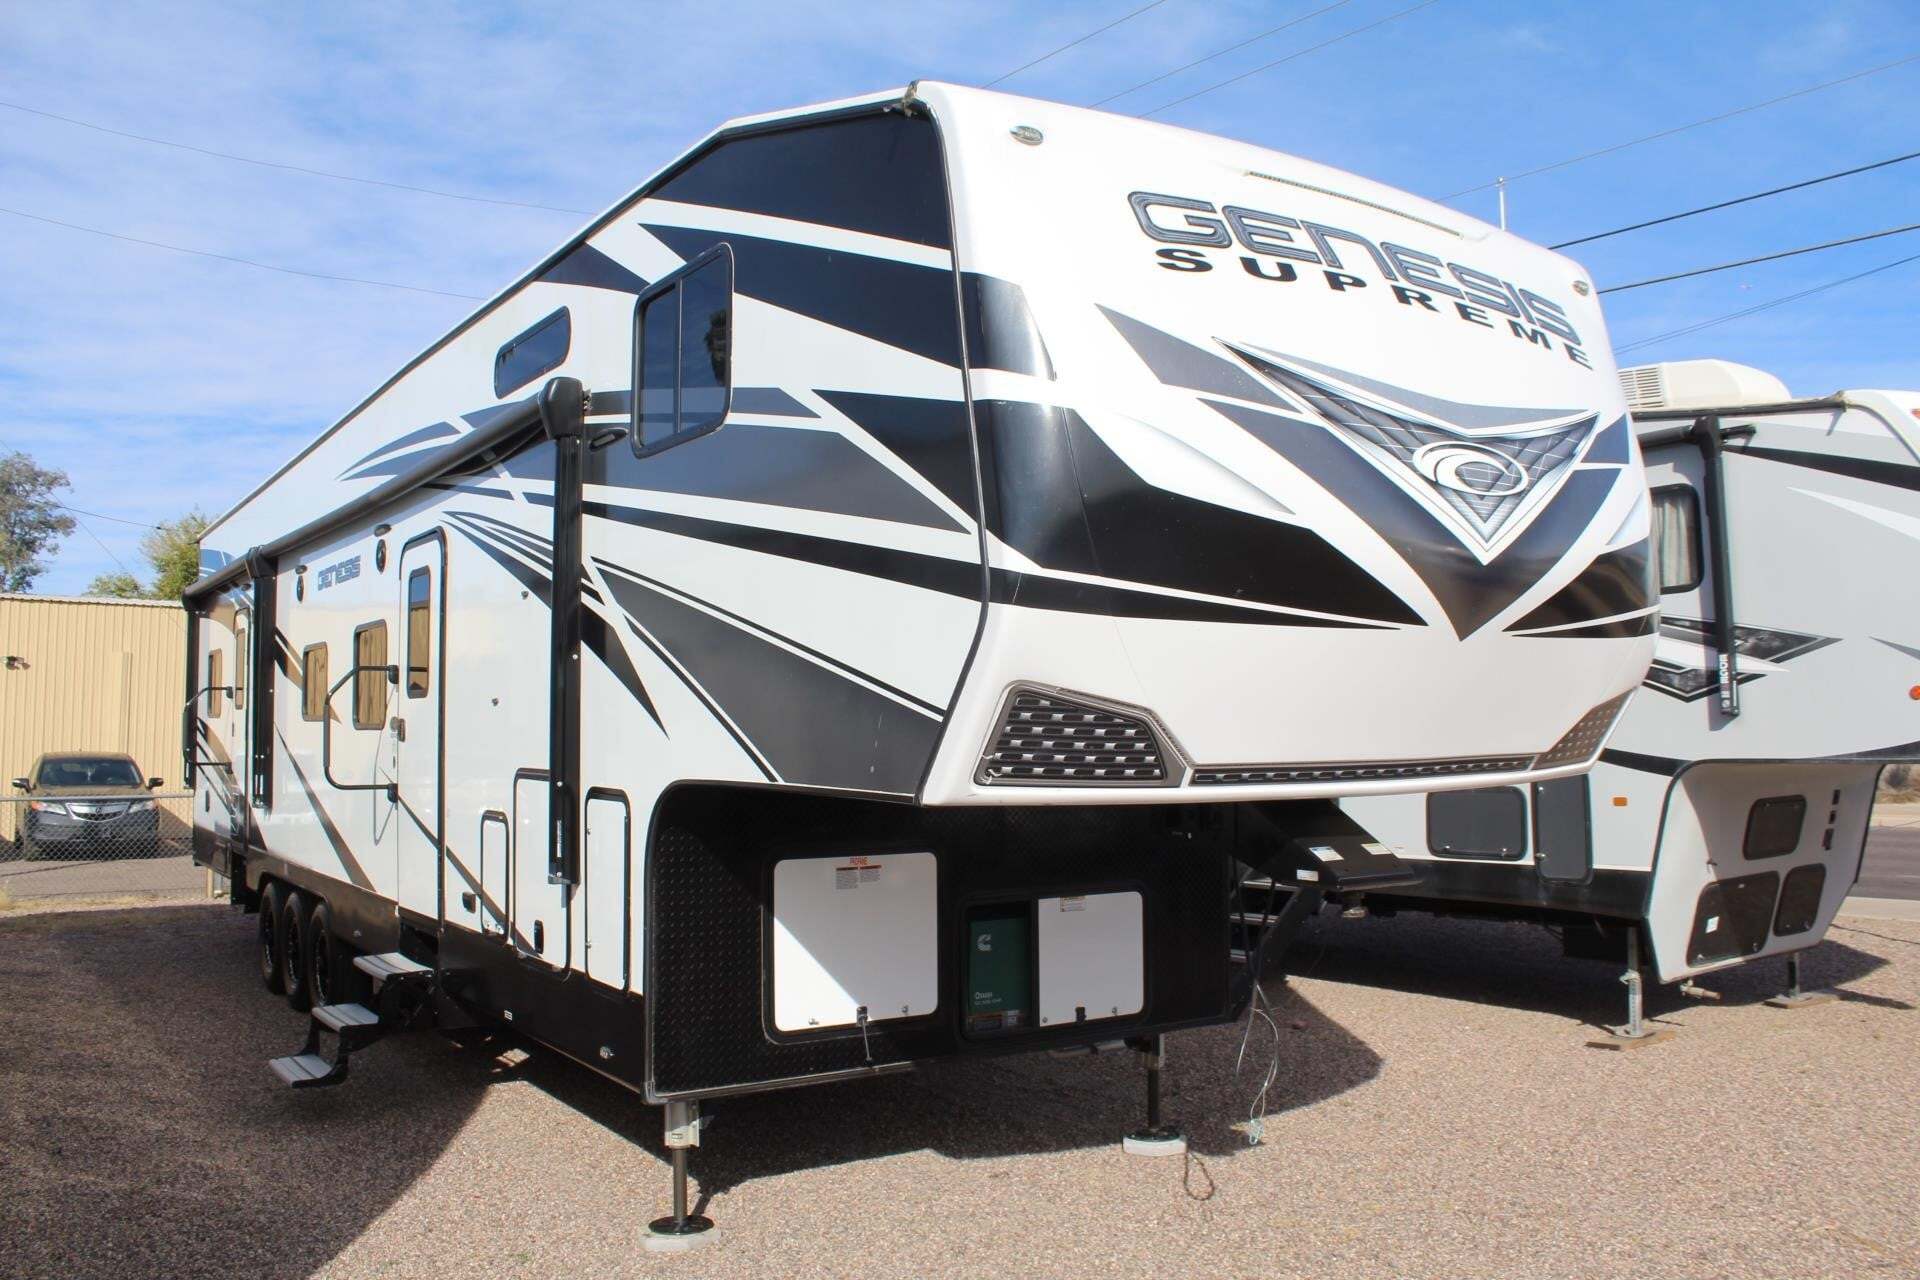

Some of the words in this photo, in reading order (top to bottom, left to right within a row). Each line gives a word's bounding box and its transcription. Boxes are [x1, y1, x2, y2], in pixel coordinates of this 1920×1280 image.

[1127, 191, 1582, 346] GENESIS
[1155, 248, 1593, 371] SUPREME
[318, 555, 361, 591] GENESIS
